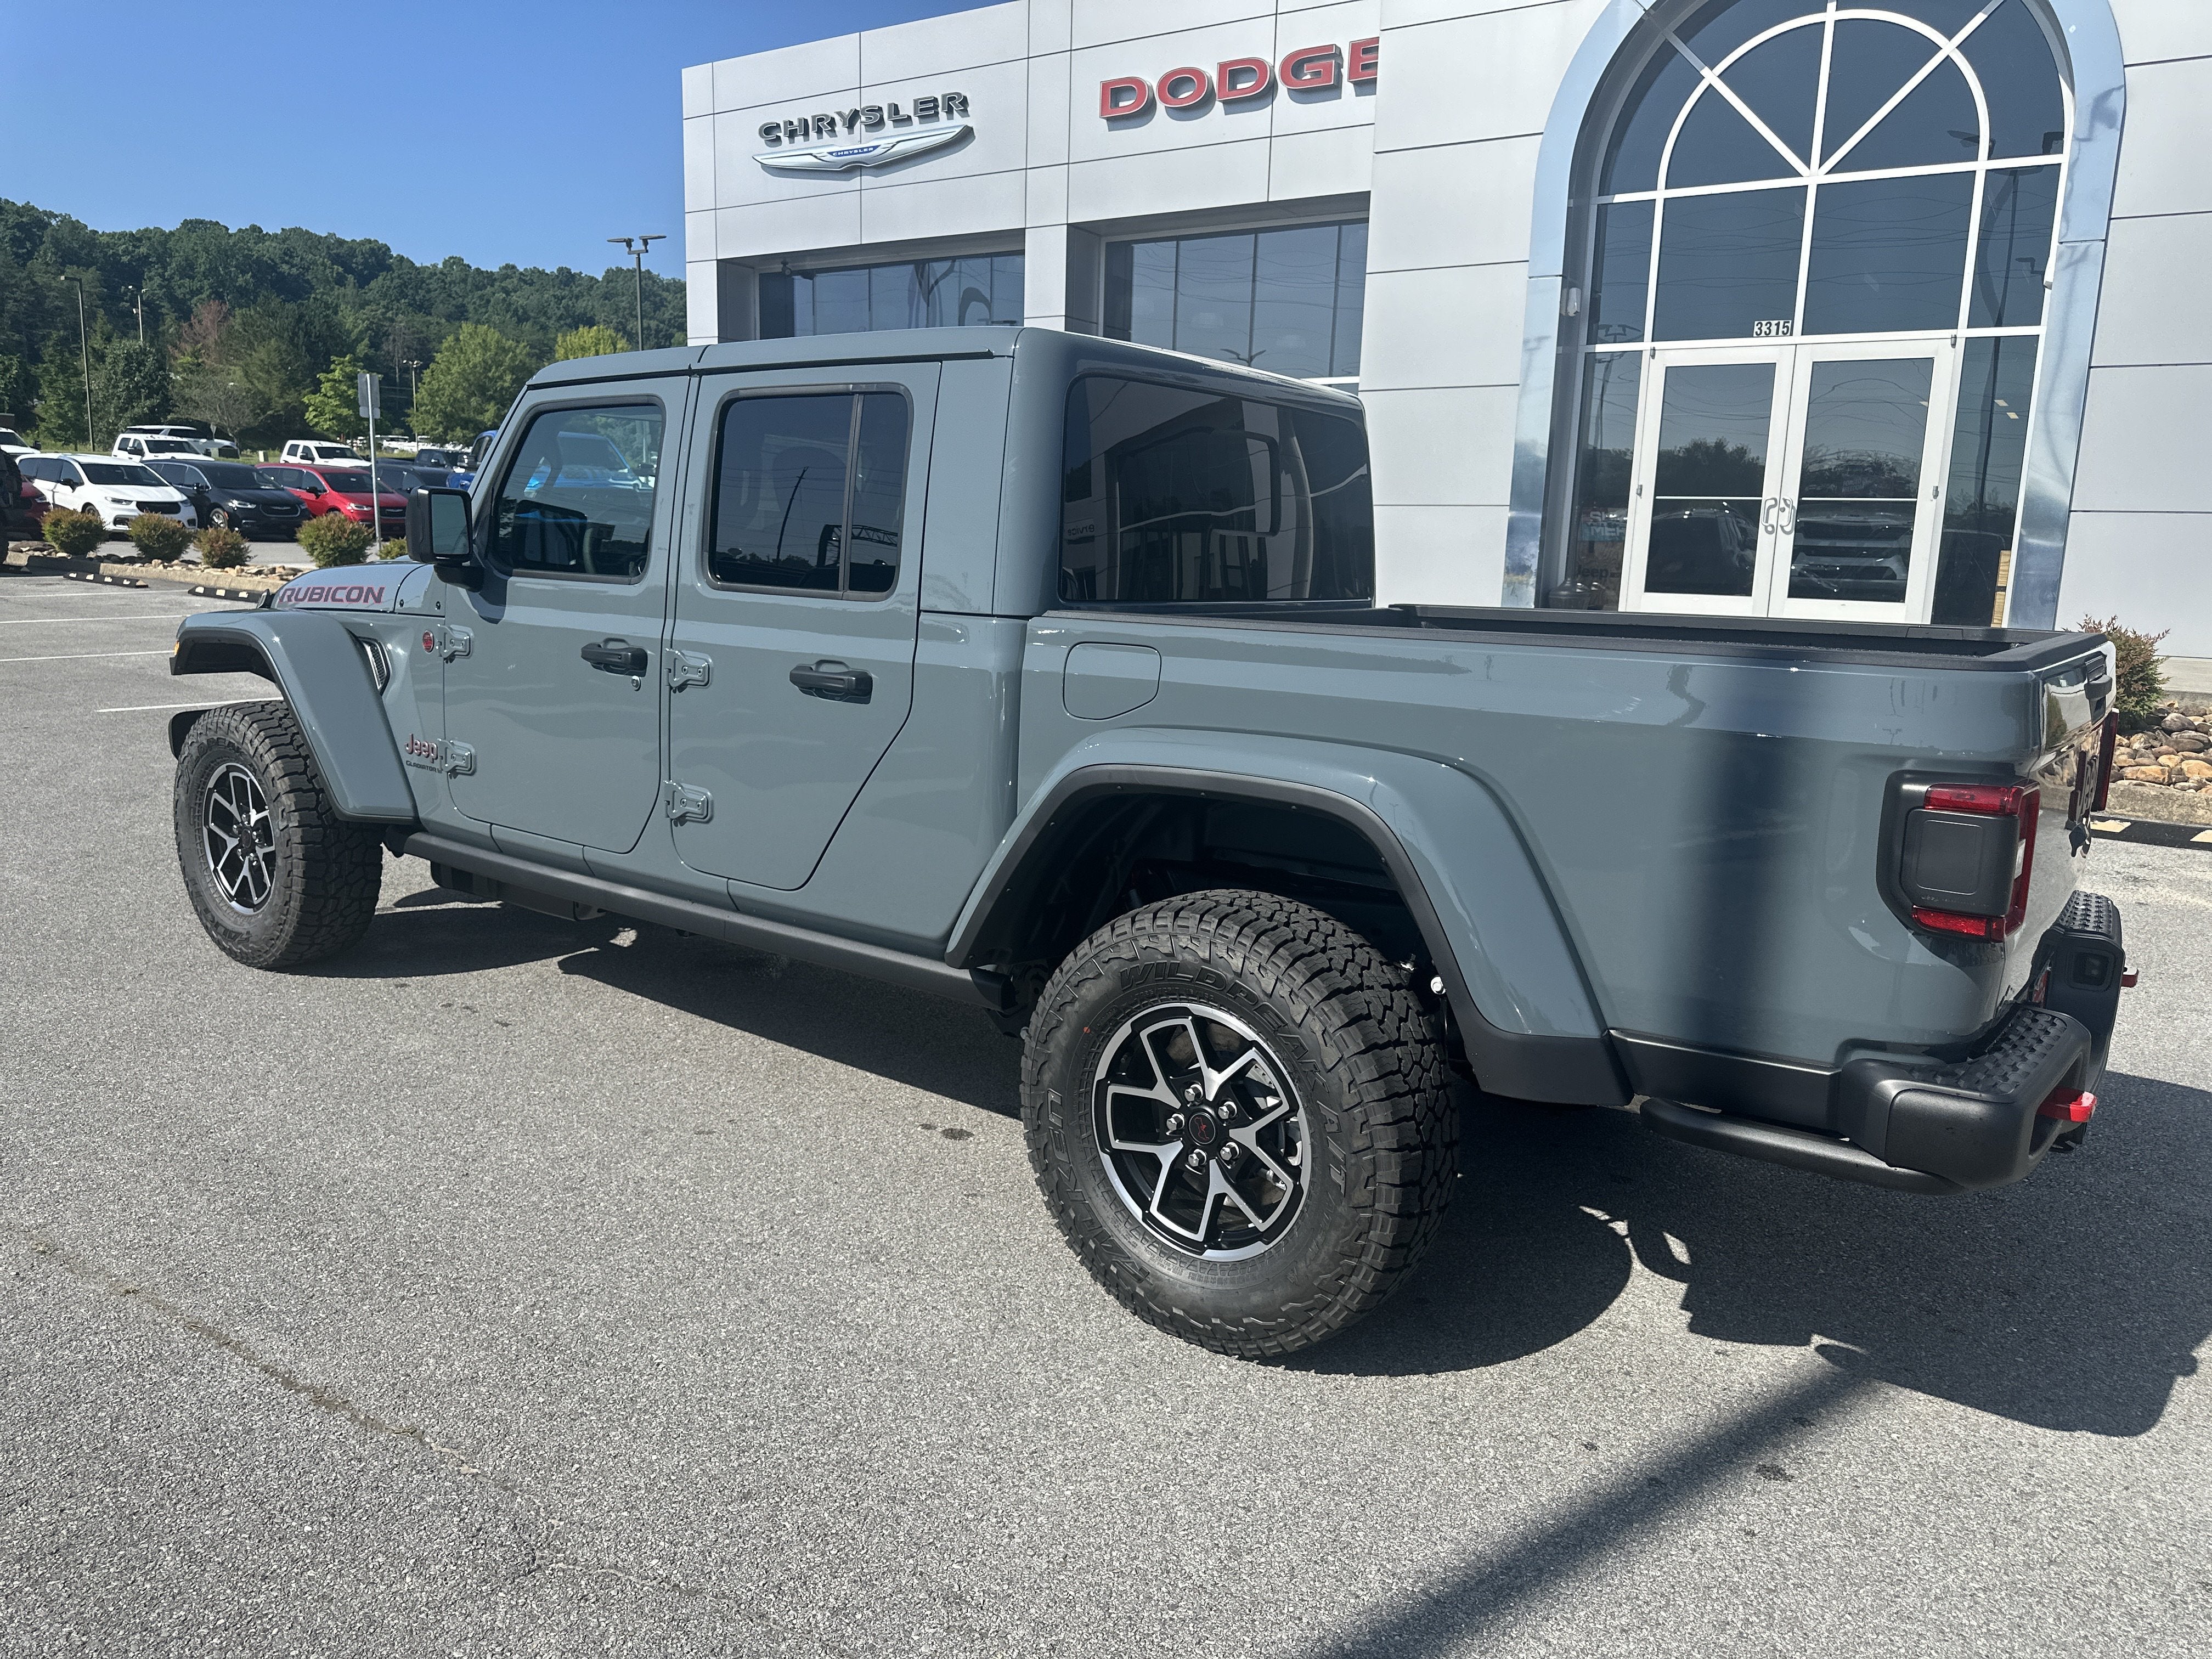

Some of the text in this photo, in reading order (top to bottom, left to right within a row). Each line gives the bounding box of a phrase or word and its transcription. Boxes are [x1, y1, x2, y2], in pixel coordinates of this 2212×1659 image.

[1099, 37, 1379, 119] DODGE
[758, 92, 969, 141] CHRYSLER
[832, 146, 874, 156] CHRYSLER
[1755, 321, 1790, 336] 3315
[279, 586, 386, 604] RUBICON
[404, 733, 438, 764] Jeep
[406, 760, 437, 774] GLADIATOR
[1120, 961, 1330, 1093] WILDPEAK
